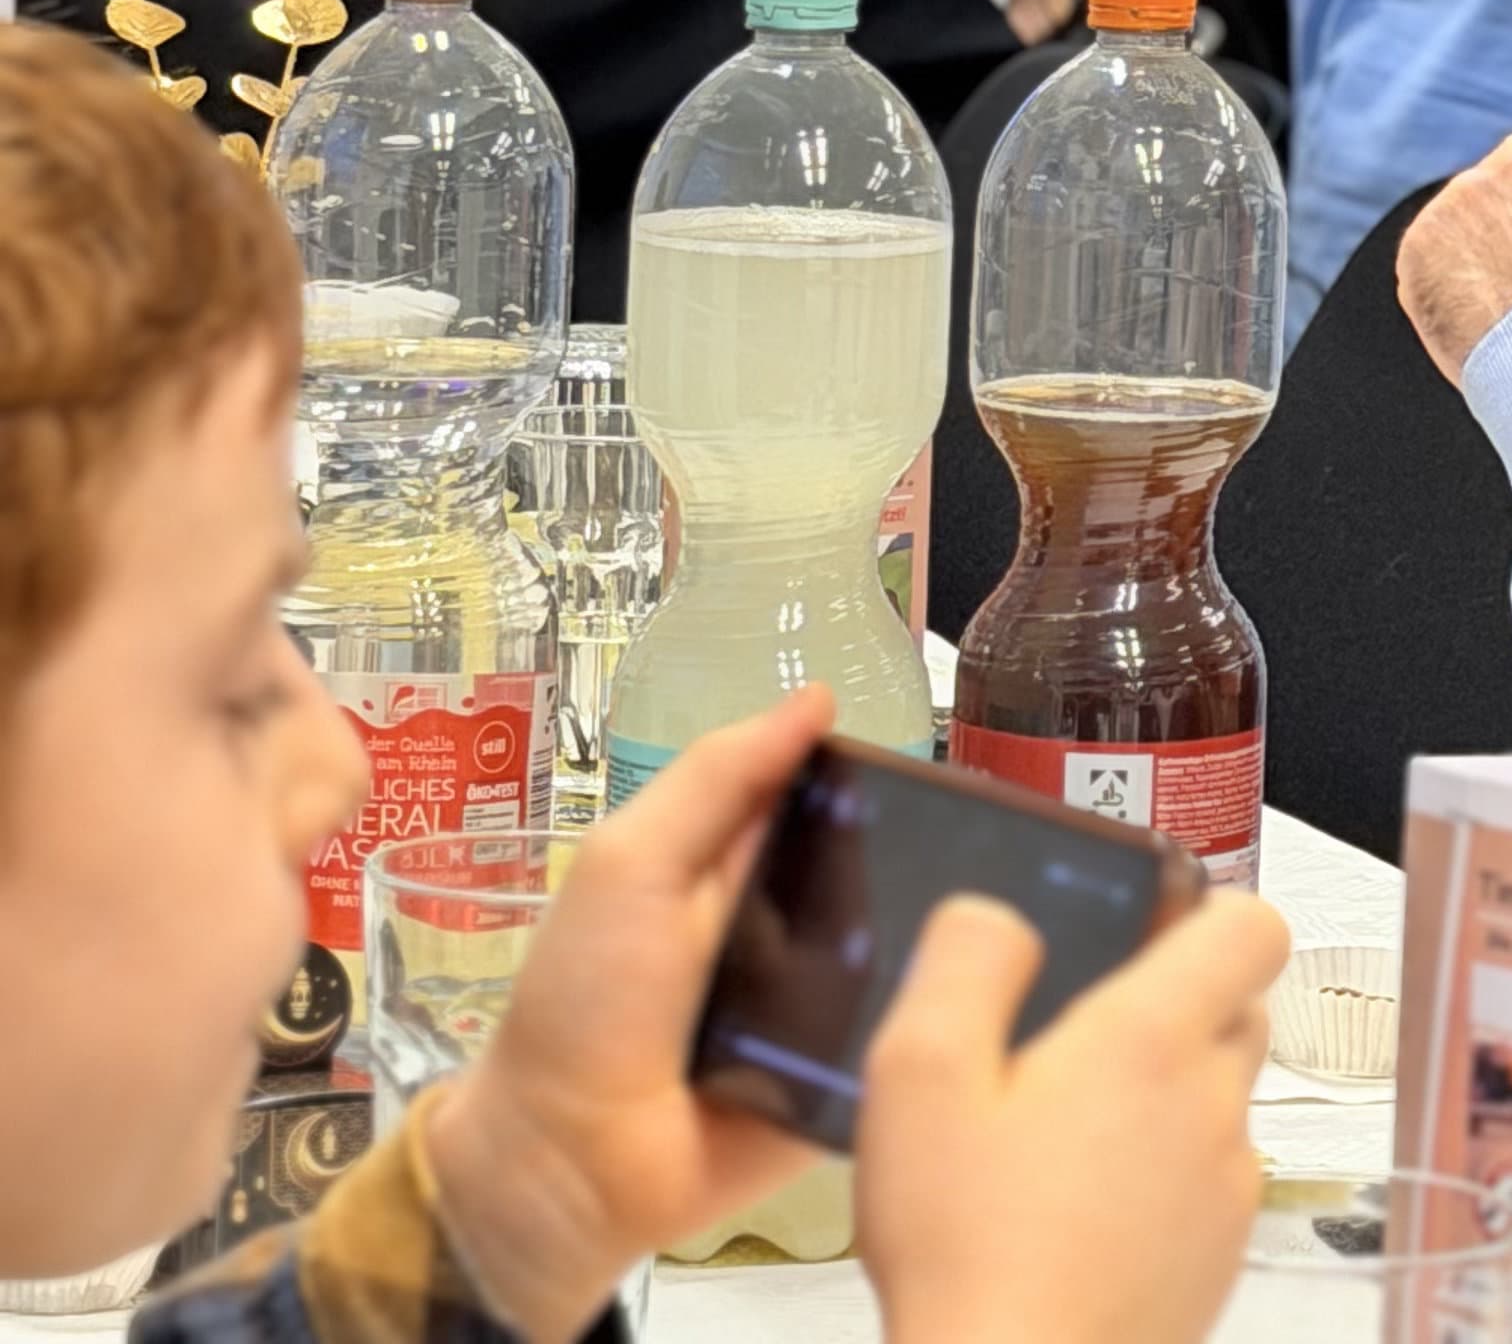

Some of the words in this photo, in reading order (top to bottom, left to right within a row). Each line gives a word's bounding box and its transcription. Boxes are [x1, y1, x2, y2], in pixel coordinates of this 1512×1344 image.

[400, 735, 456, 753] Quelle
[376, 757, 403, 771] am
[408, 754, 457, 772] Rhein
[369, 777, 457, 802] LICHES
